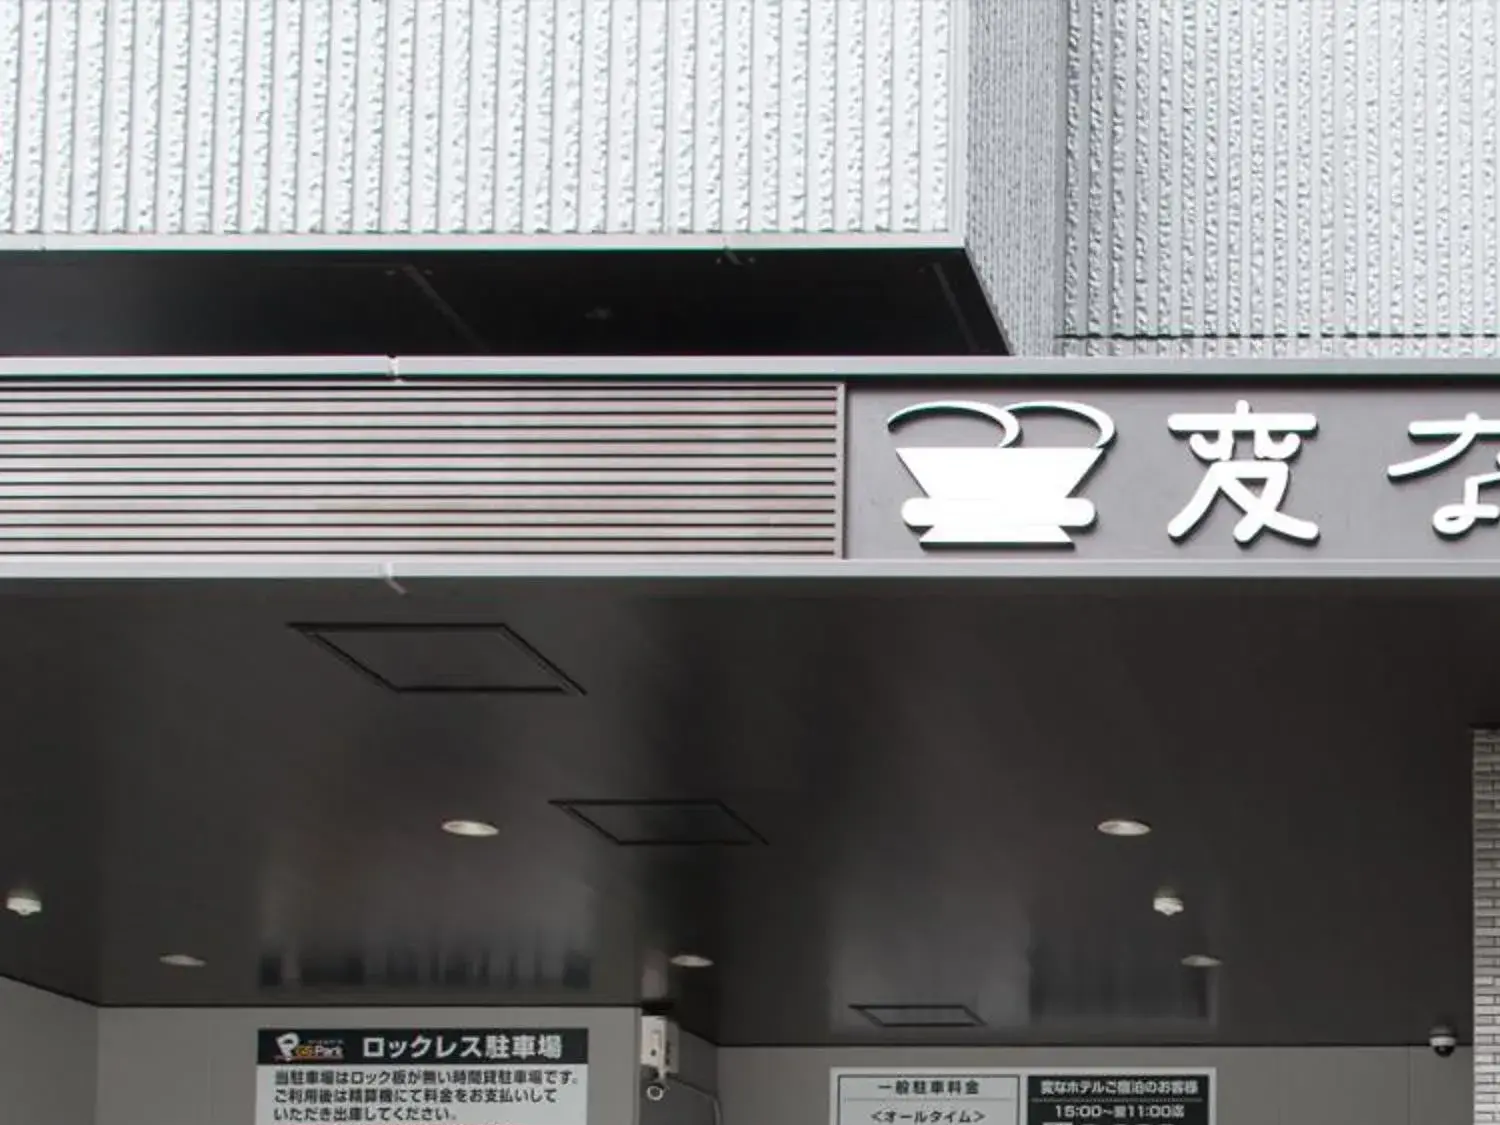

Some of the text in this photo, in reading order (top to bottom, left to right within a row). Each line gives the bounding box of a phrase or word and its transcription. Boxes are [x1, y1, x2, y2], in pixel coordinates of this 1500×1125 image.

[362, 1035, 562, 1059] ロックレス駐車場
[878, 1080, 979, 1095] 一般駐車料金
[1040, 1080, 1198, 1094] 変なホテルご宿泊のお客様
